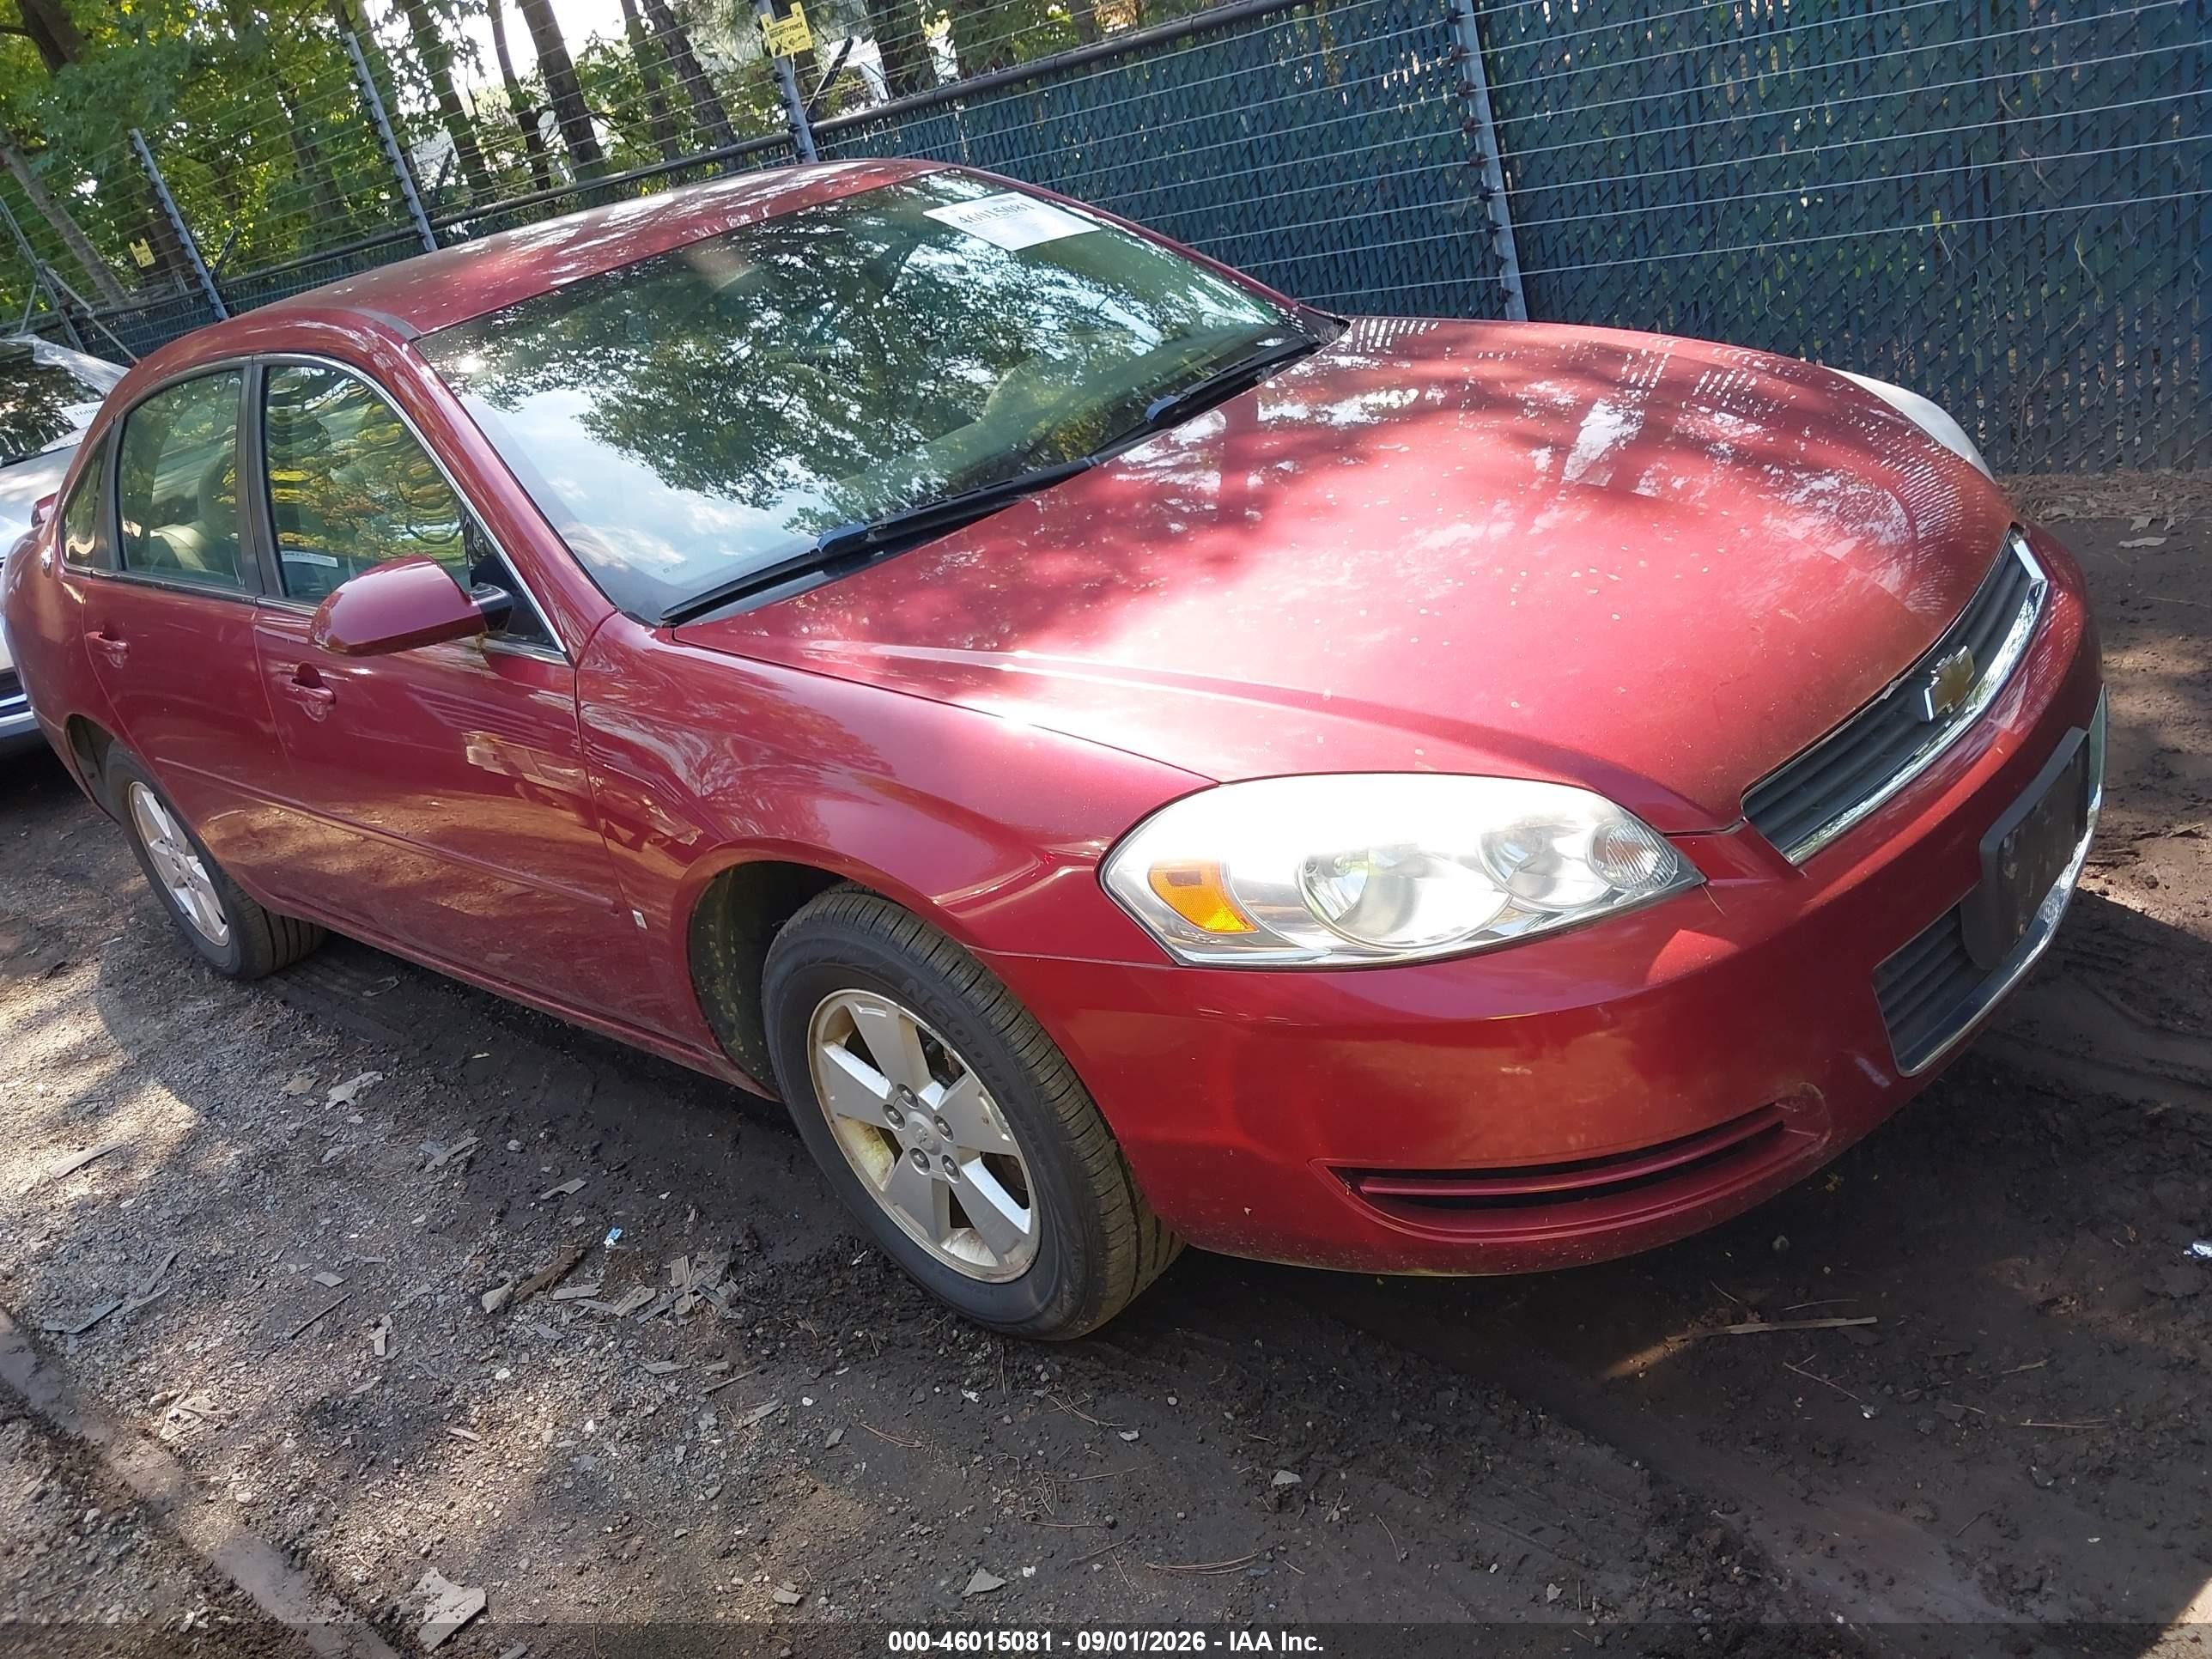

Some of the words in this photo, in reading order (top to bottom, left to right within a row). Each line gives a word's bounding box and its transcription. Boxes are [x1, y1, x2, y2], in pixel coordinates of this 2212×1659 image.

[769, 27, 788, 39] SECURITY
[789, 21, 804, 31] FENCE
[957, 202, 1036, 224] 46015081
